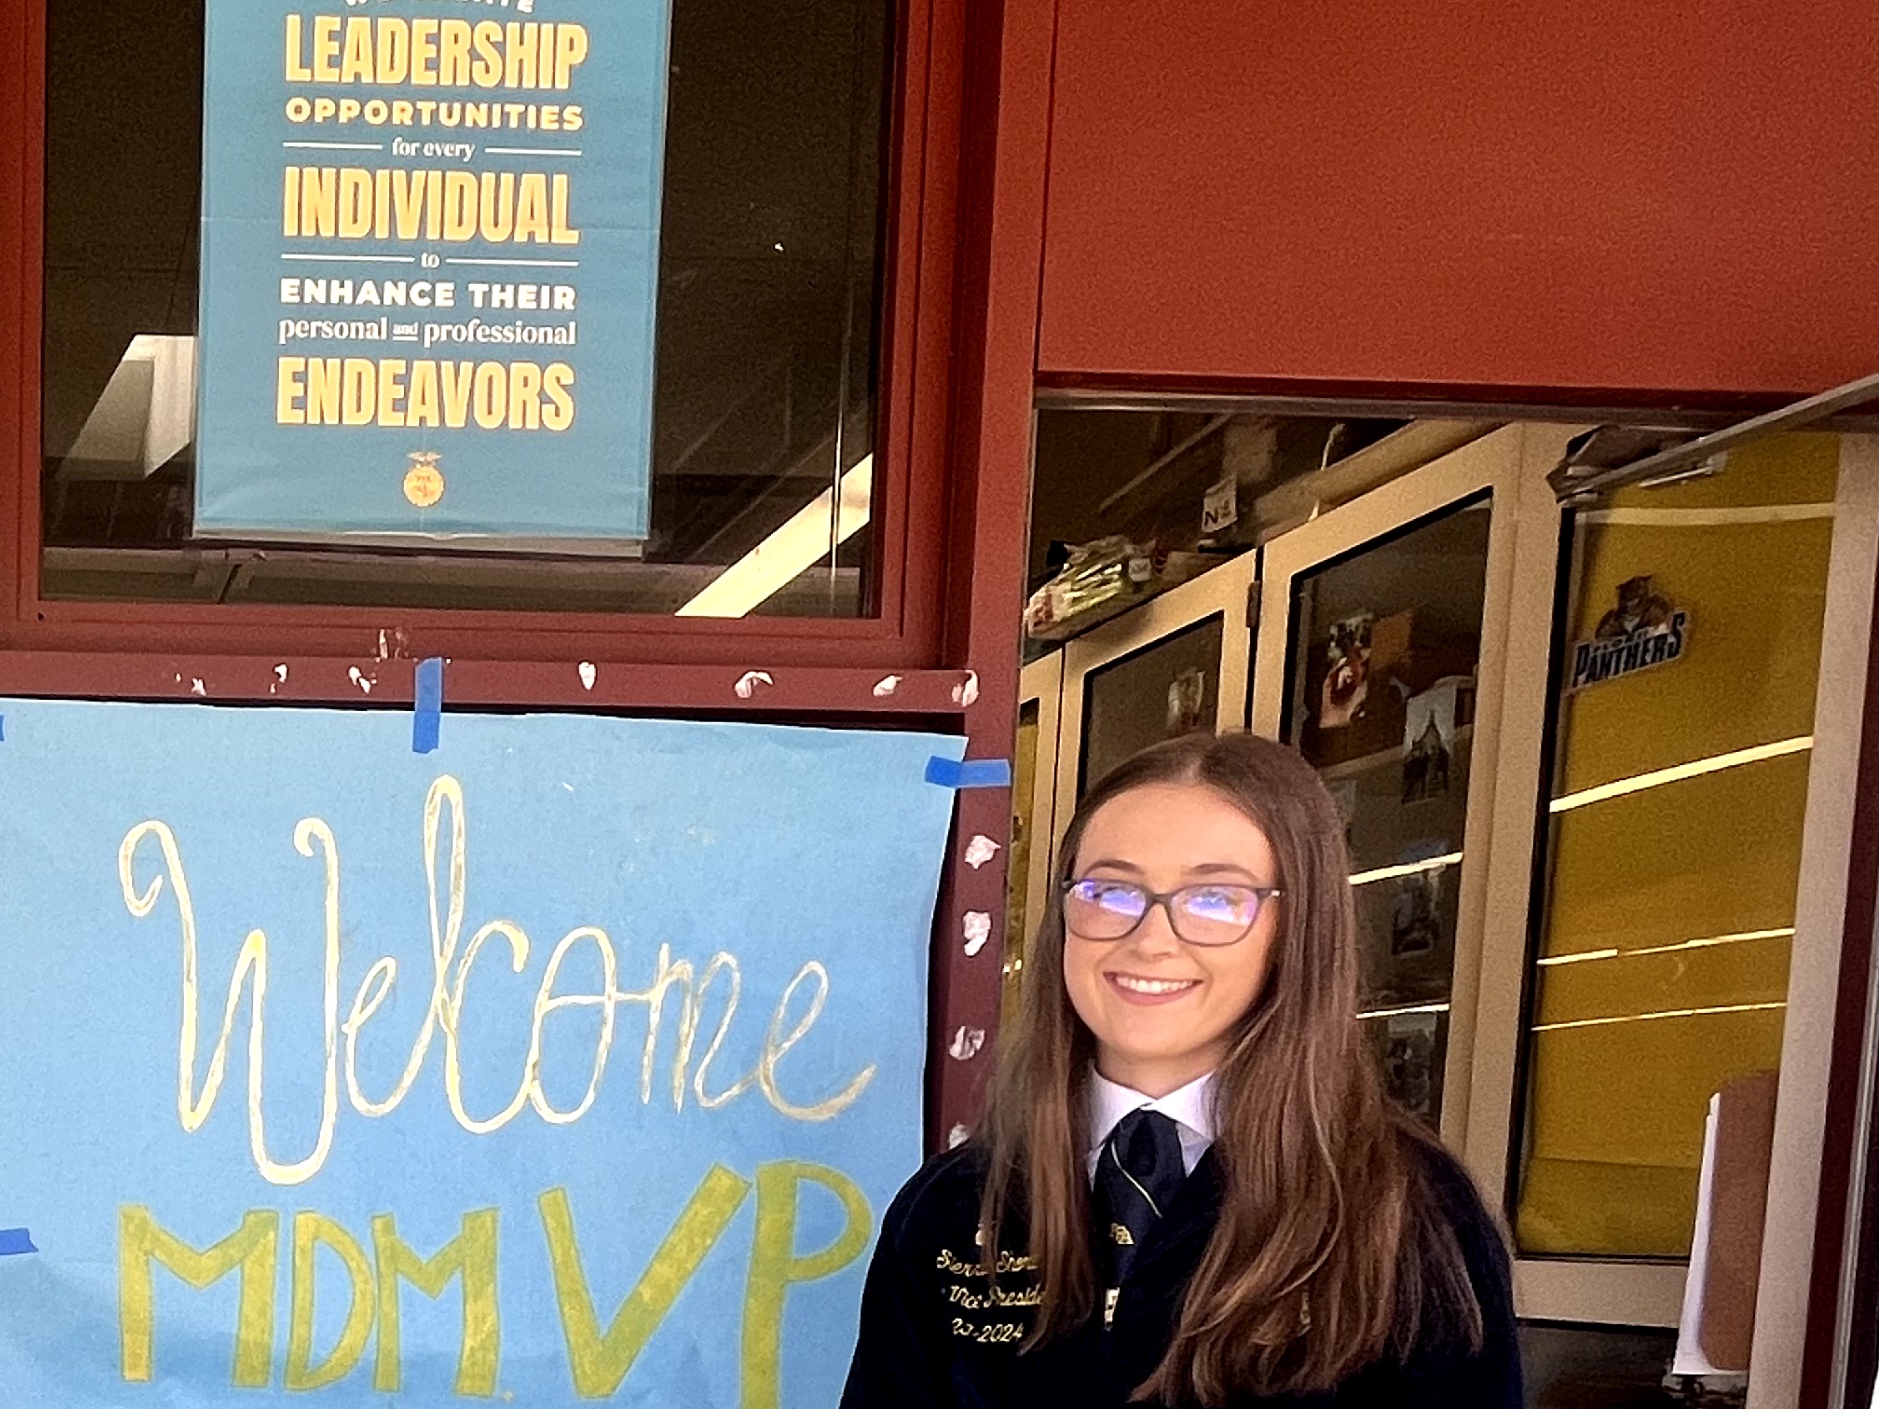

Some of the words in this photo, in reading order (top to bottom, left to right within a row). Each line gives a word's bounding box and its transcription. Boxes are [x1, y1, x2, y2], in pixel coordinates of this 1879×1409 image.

[285, 15, 588, 90] LEADERSHIP
[285, 97, 583, 131] OPPORTUNITIES
[392, 137, 420, 158] for
[423, 141, 475, 162] every
[282, 166, 580, 244] INDIVIDUAL
[421, 252, 440, 268] to
[280, 278, 455, 308] ENHANCE
[469, 283, 576, 311] THEIR
[278, 317, 388, 346] personal
[392, 322, 419, 336] and
[423, 319, 577, 347] professional
[277, 357, 575, 431] ENDEAVORS
[117, 774, 879, 1186] Welcome
